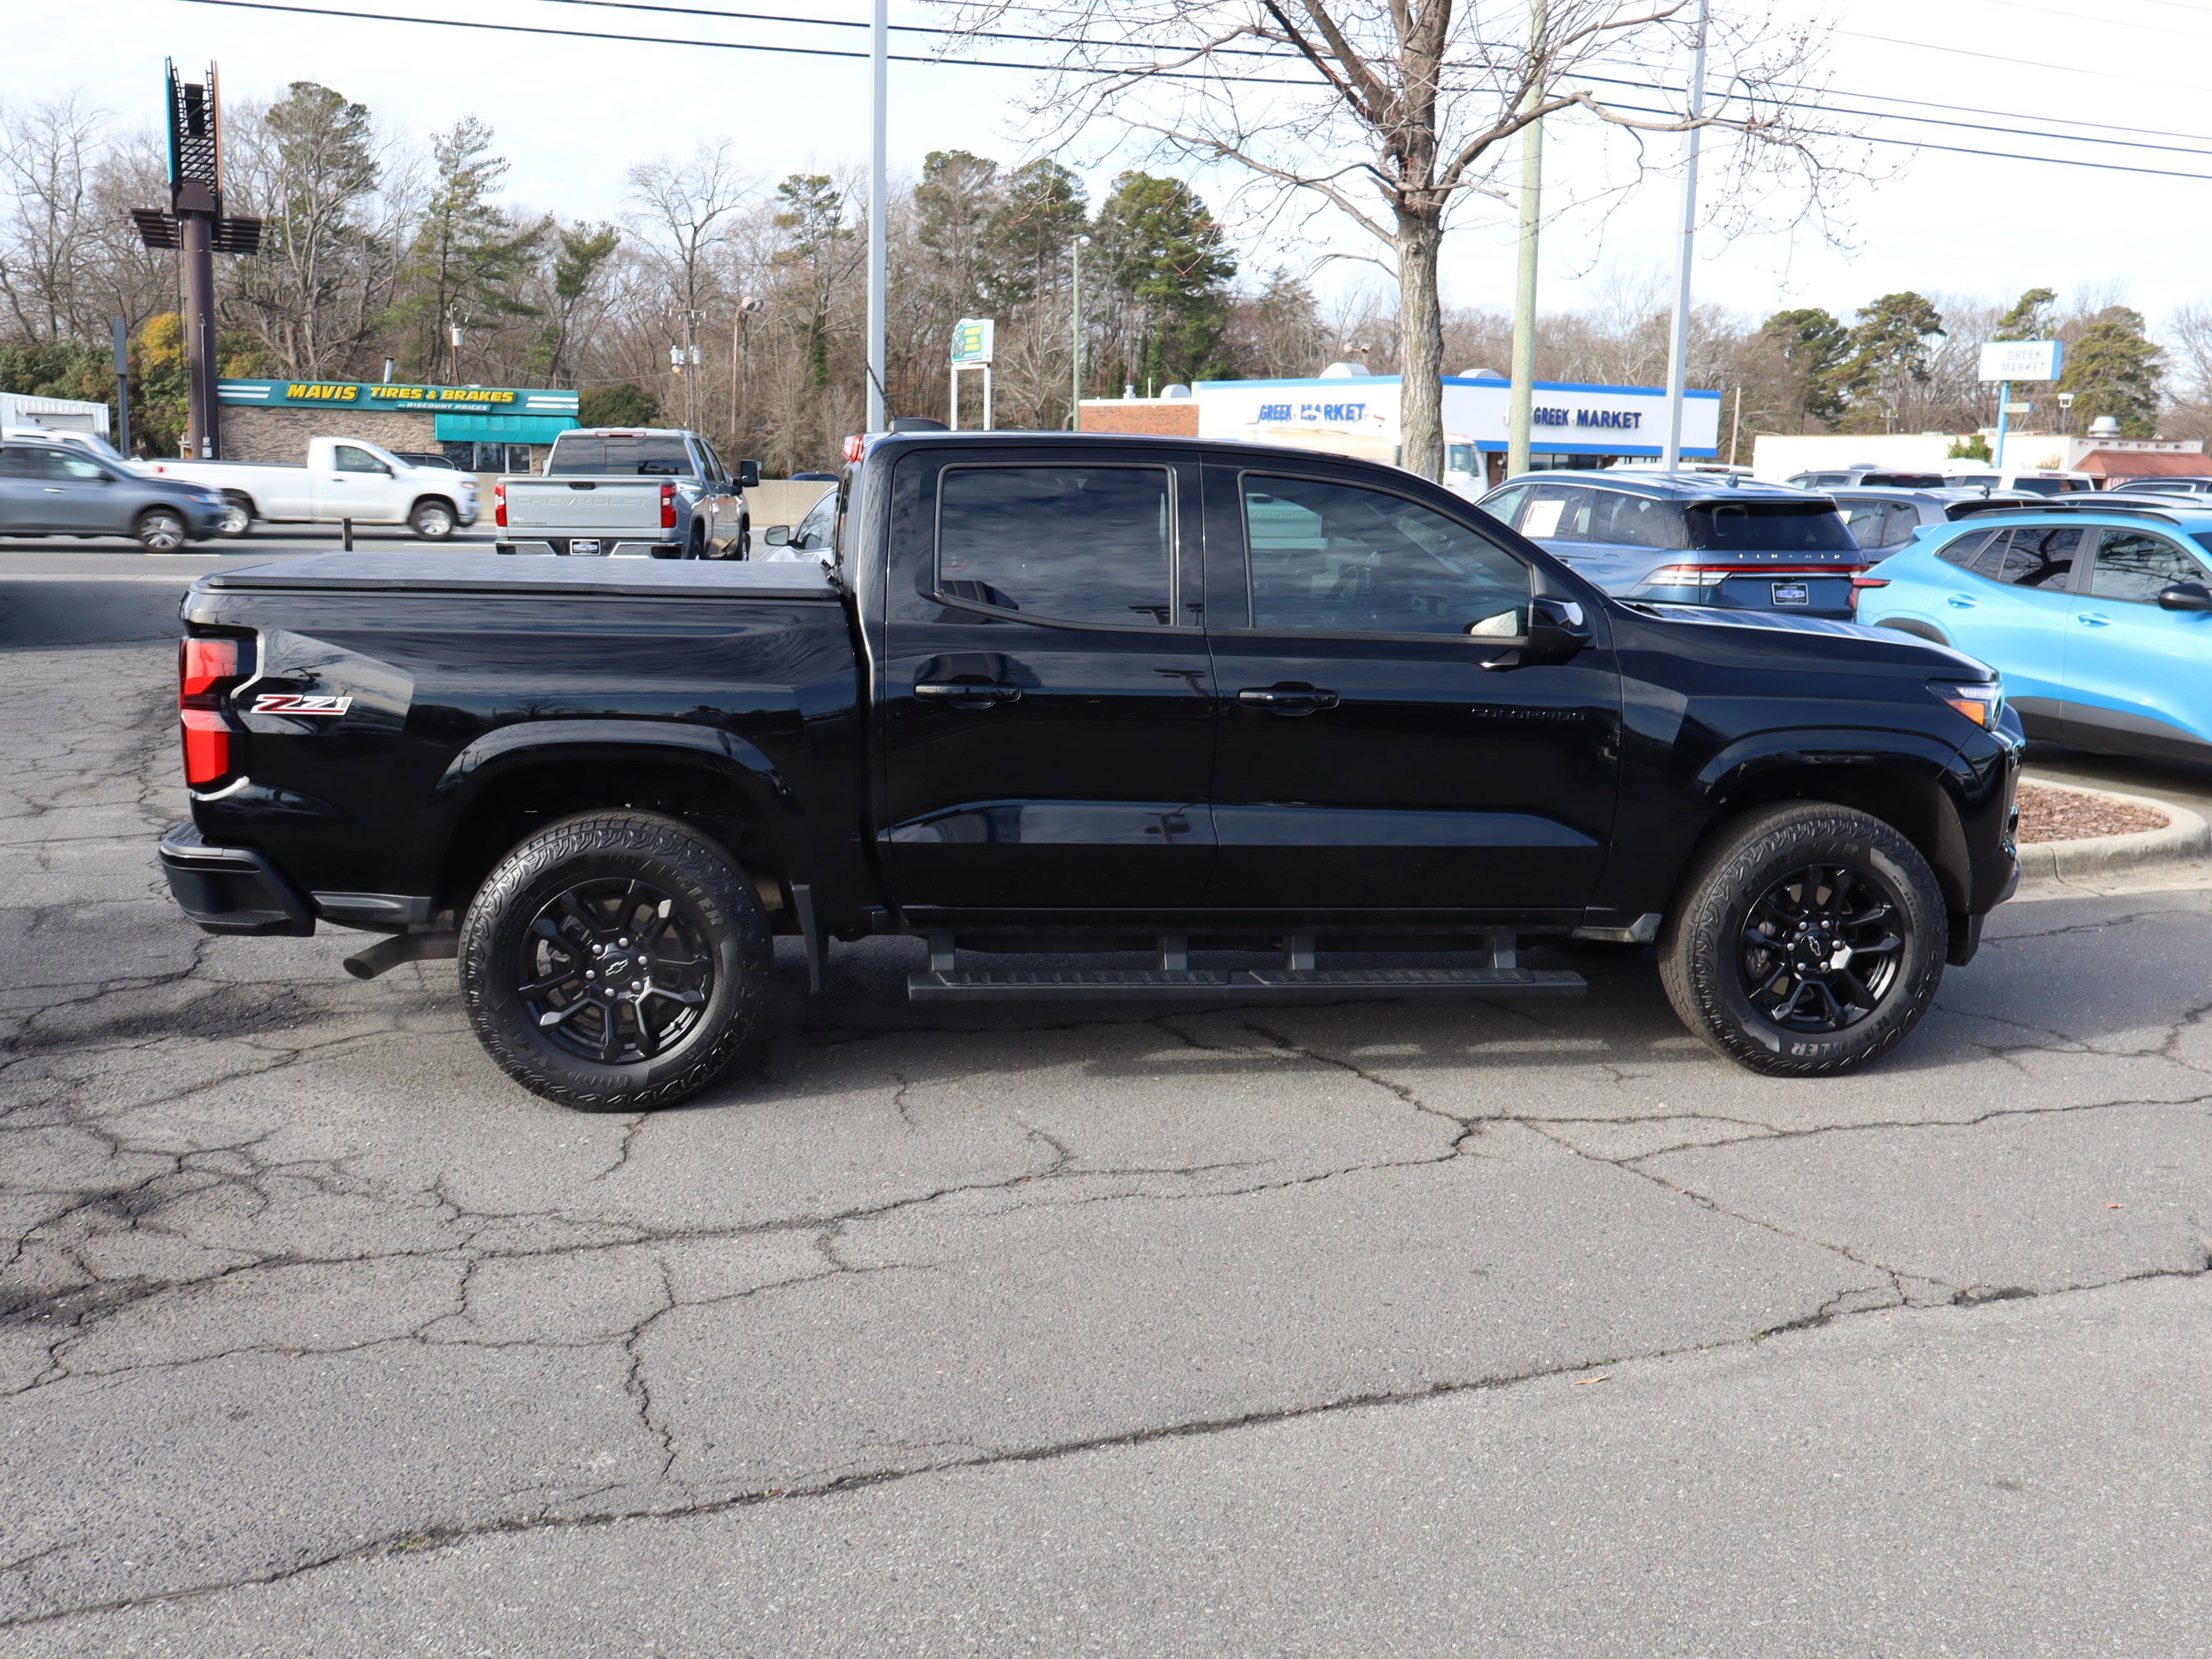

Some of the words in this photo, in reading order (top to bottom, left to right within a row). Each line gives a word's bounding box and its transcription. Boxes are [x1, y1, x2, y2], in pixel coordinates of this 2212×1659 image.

[2008, 350, 2042, 361] GREEK
[2001, 362, 2045, 372] MARKET
[286, 384, 357, 400] MAVIS
[371, 386, 423, 399] TIRES
[426, 390, 437, 400] &
[441, 390, 515, 402] BRAKES
[1259, 404, 1293, 421] GREEK
[1533, 406, 1569, 426] GREEK
[1577, 409, 1642, 429] MARKET
[251, 694, 353, 715] Z71
